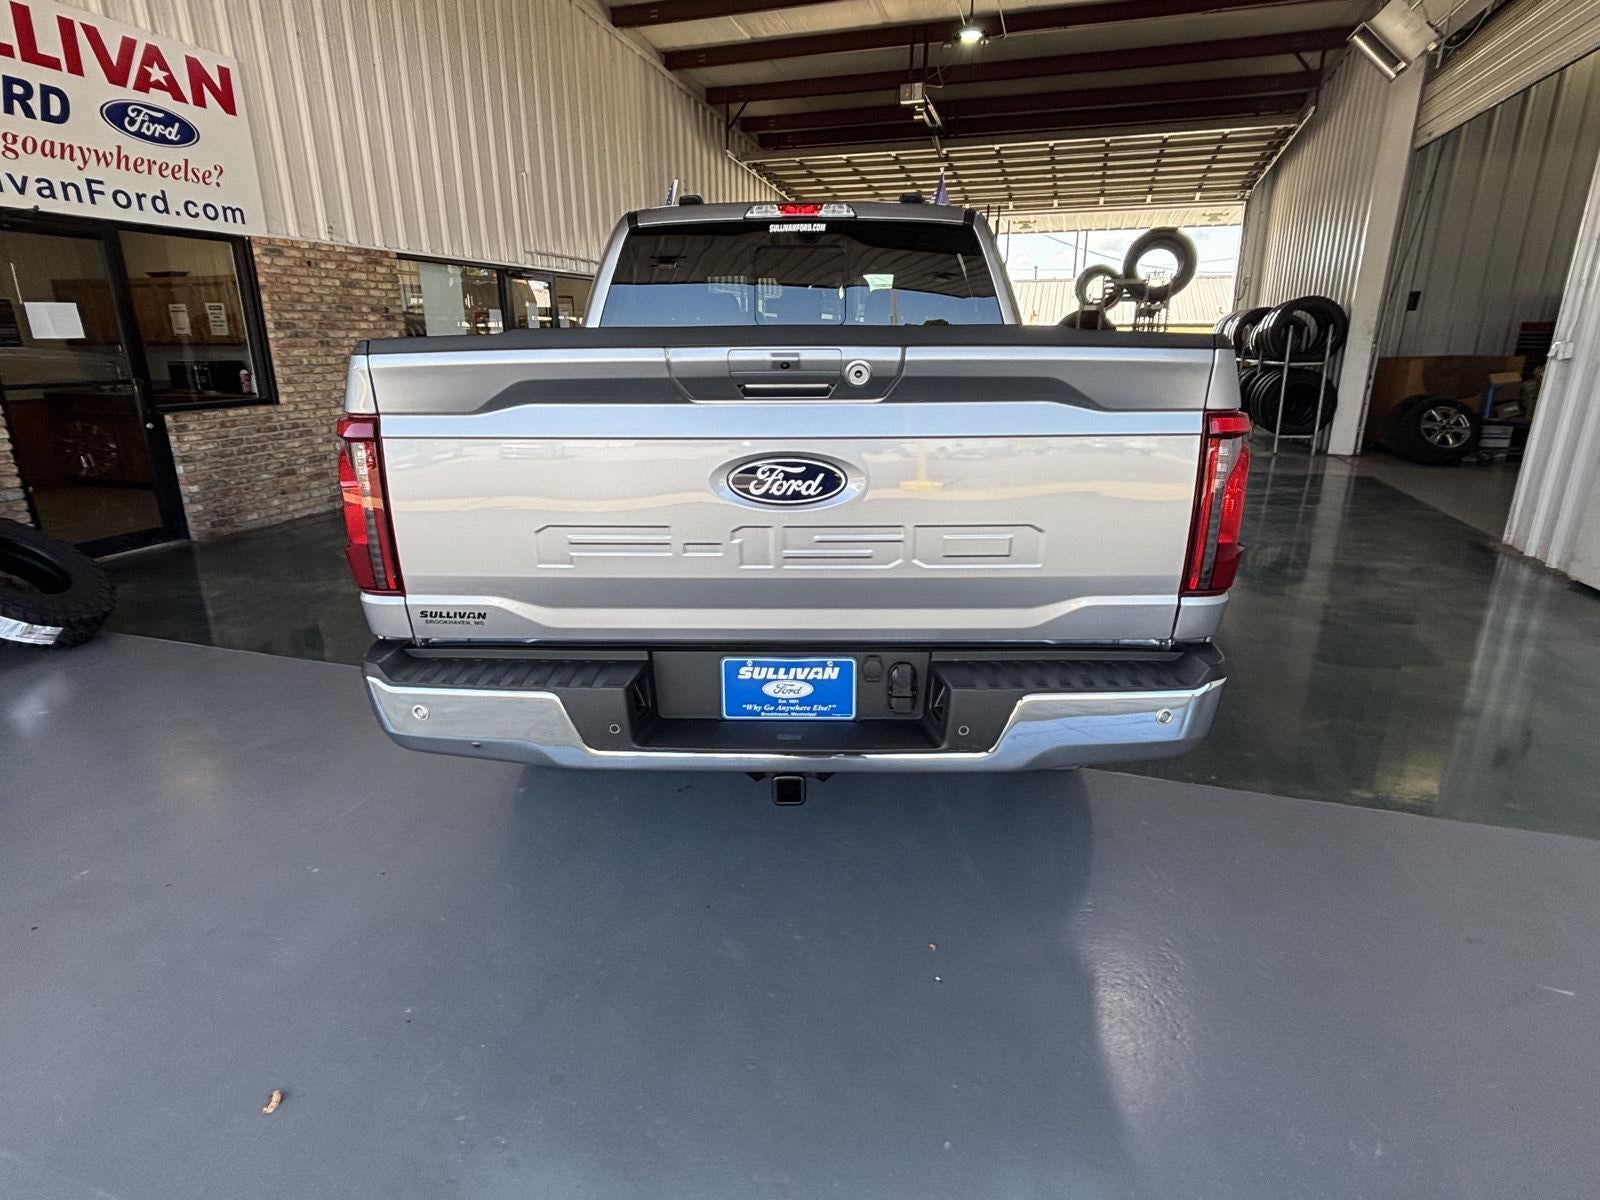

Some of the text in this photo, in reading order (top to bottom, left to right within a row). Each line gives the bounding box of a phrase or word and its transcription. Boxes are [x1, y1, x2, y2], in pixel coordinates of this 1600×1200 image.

[123, 103, 181, 142] Ford
[769, 223, 827, 233] SULLIVANFORD.COM
[748, 465, 824, 498] Ford
[535, 524, 1045, 569] F-150
[420, 610, 486, 619] SULLIVAN
[737, 666, 840, 680] SULLIVAN
[773, 683, 803, 695] Ford
[776, 704, 811, 712] Anywhere
